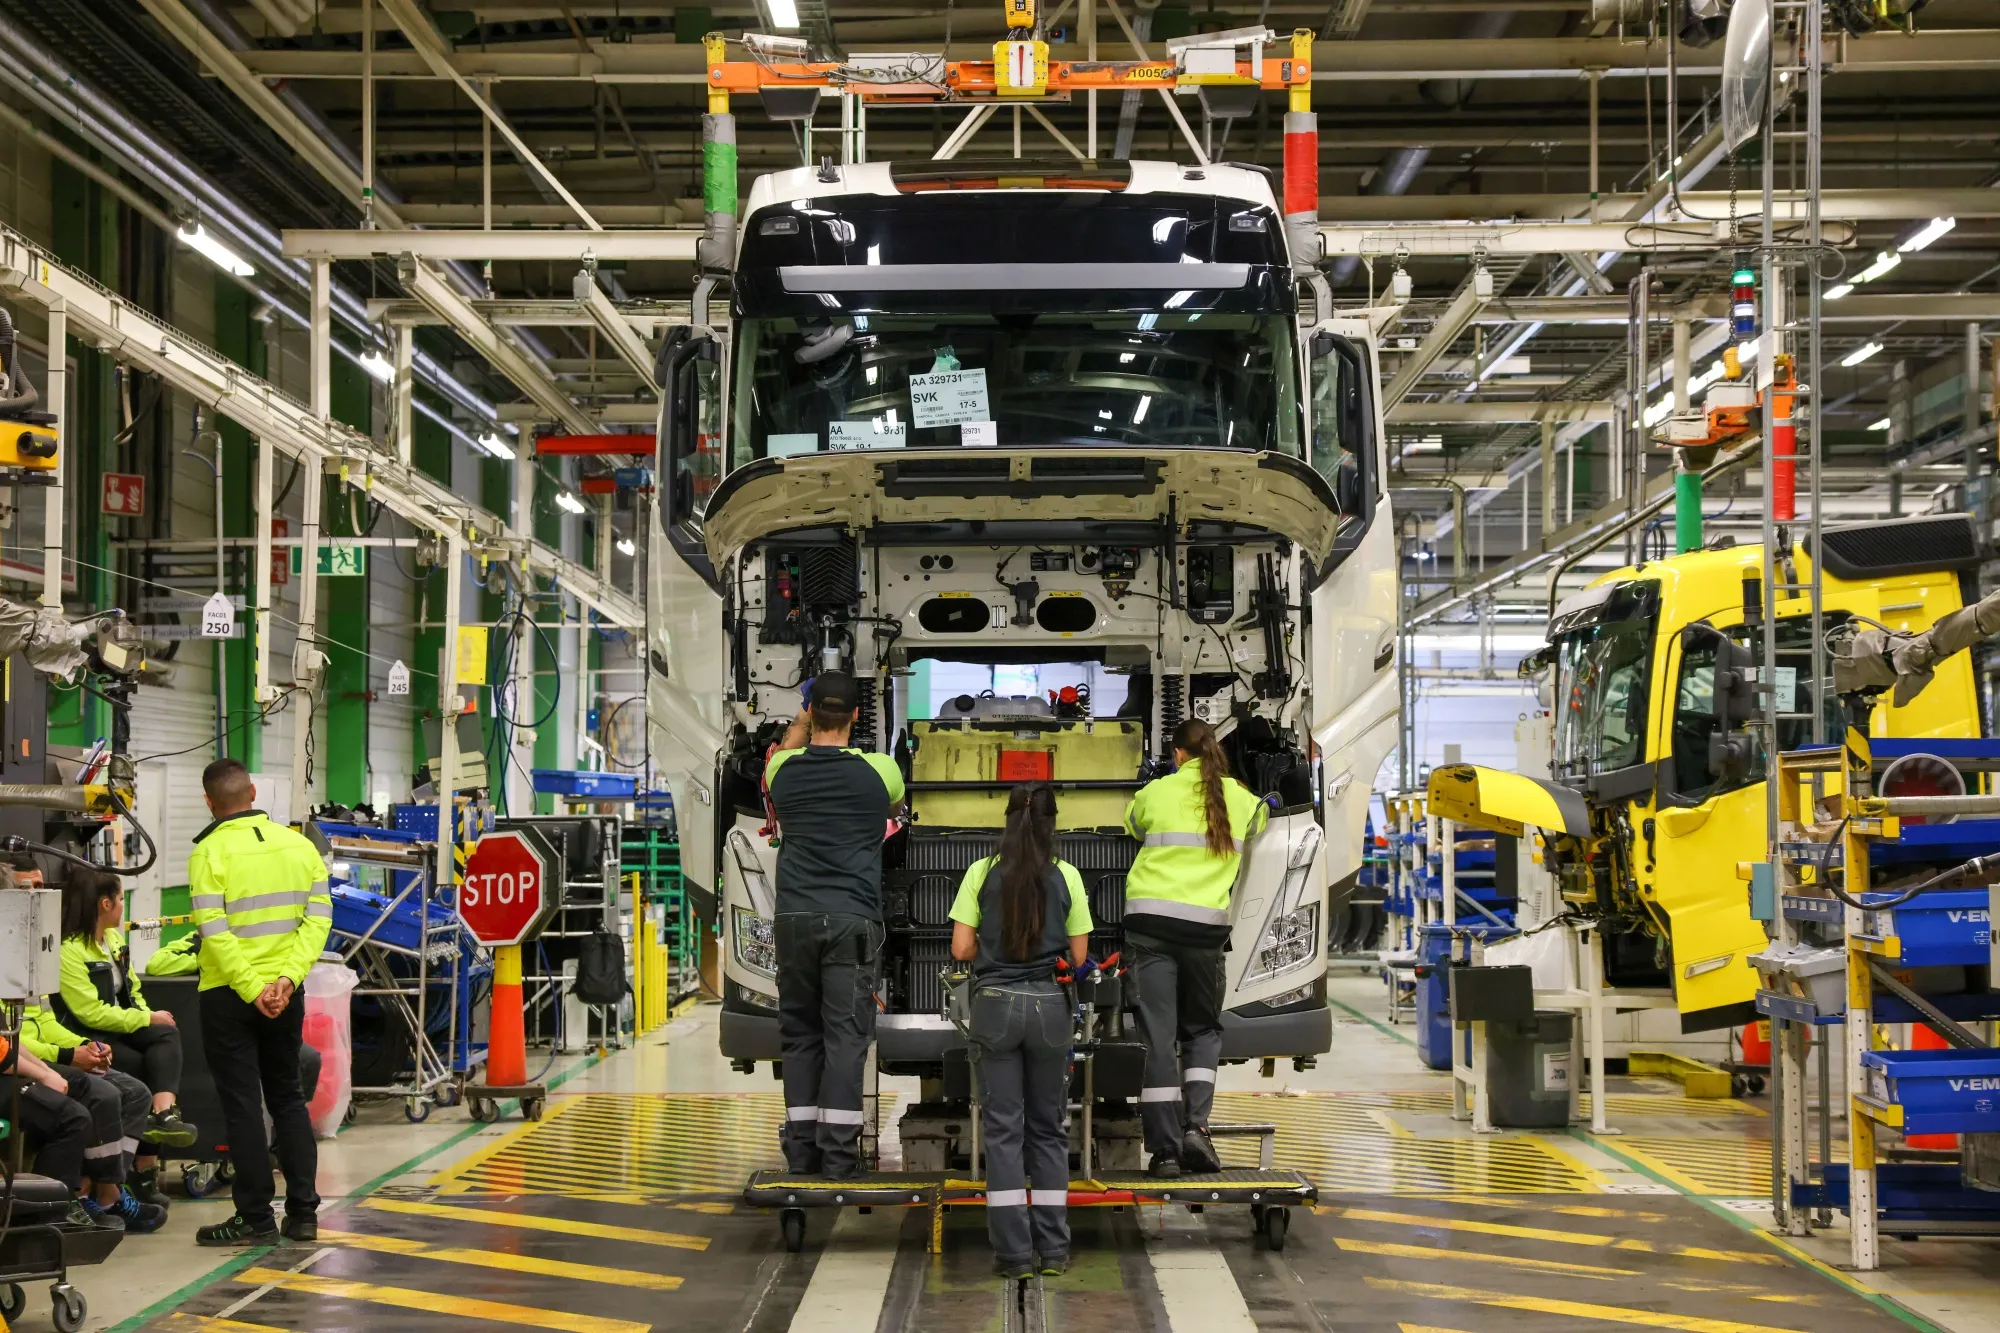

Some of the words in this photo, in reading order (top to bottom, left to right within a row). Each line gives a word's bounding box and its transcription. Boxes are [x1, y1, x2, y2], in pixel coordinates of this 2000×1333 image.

[911, 377, 927, 387] AA
[928, 374, 962, 385] 329731
[913, 391, 938, 403] SVK
[959, 400, 977, 409] 17-5
[830, 425, 843, 435] AA
[873, 425, 904, 435] 9731
[961, 427, 981, 435] 329731
[206, 622, 230, 634] 250
[391, 683, 407, 693] 245
[464, 871, 535, 907] STOP
